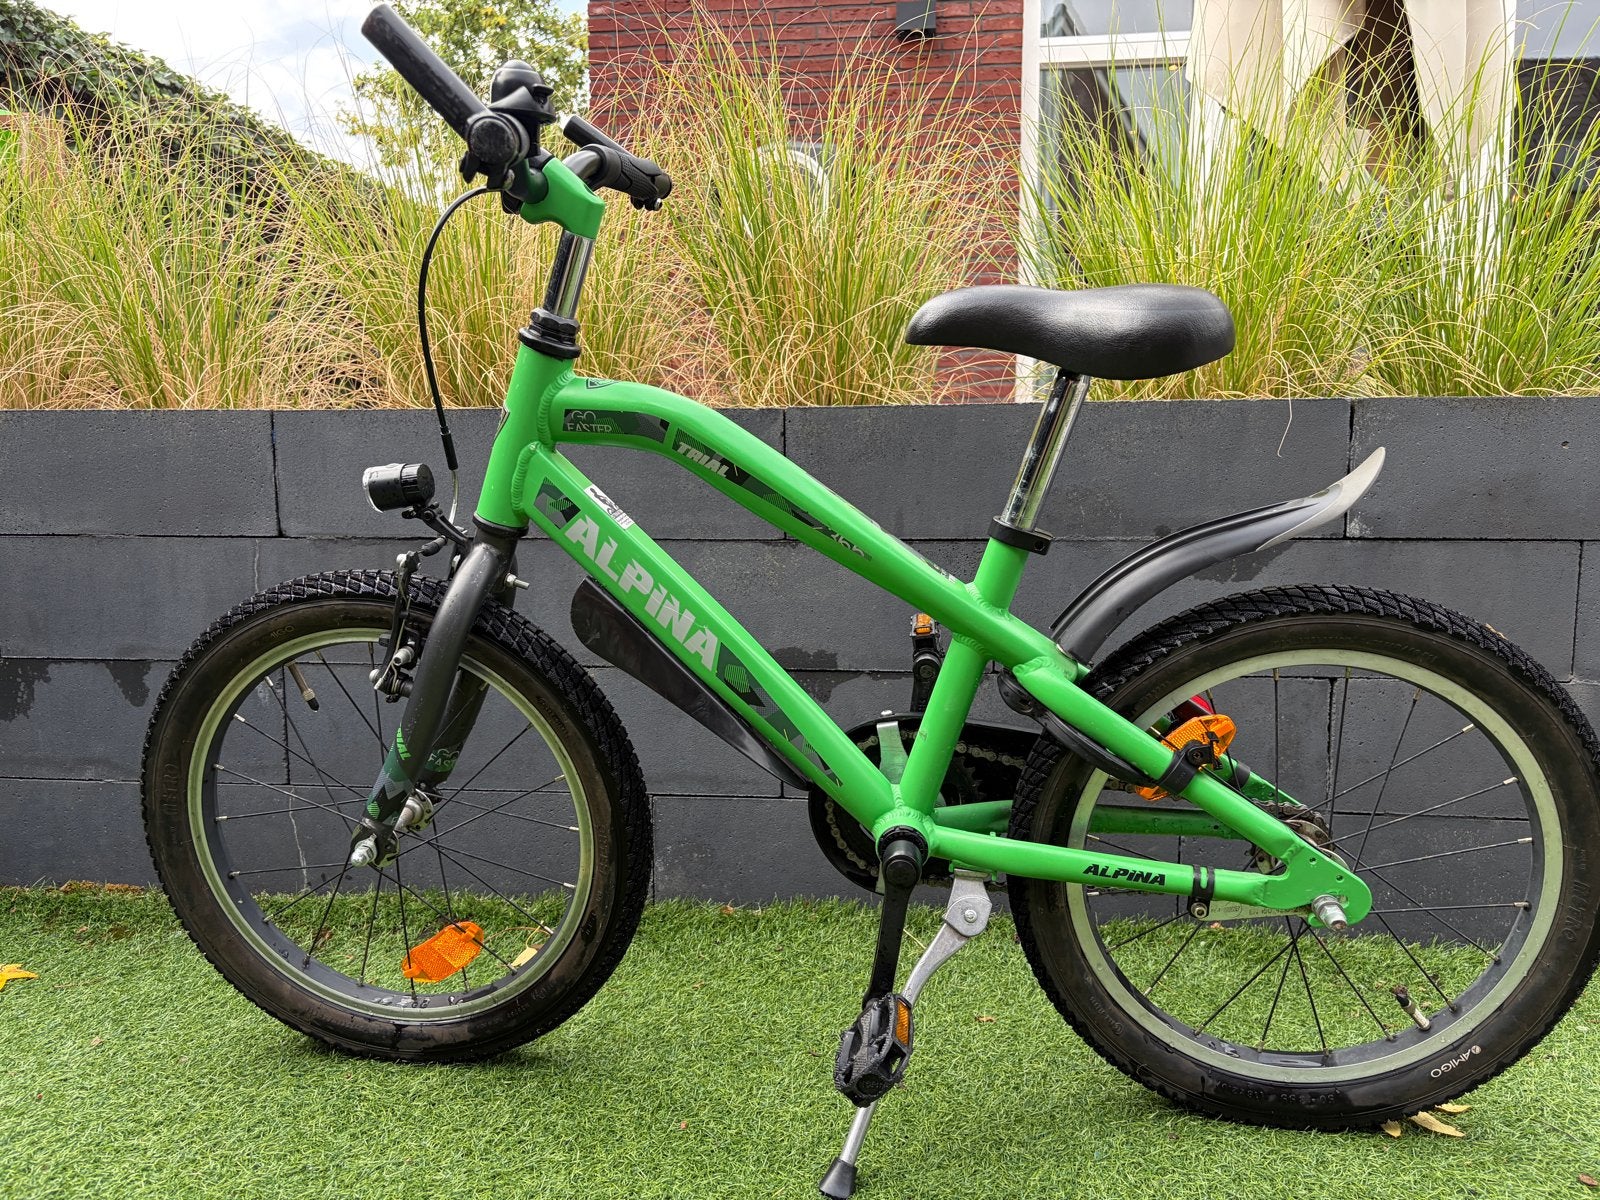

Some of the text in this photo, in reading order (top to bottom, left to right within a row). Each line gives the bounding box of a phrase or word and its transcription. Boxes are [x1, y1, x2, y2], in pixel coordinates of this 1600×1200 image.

[571, 410, 597, 422] GO
[676, 441, 730, 478] TRIAL
[1430, 1048, 1473, 1078] AMIGO
